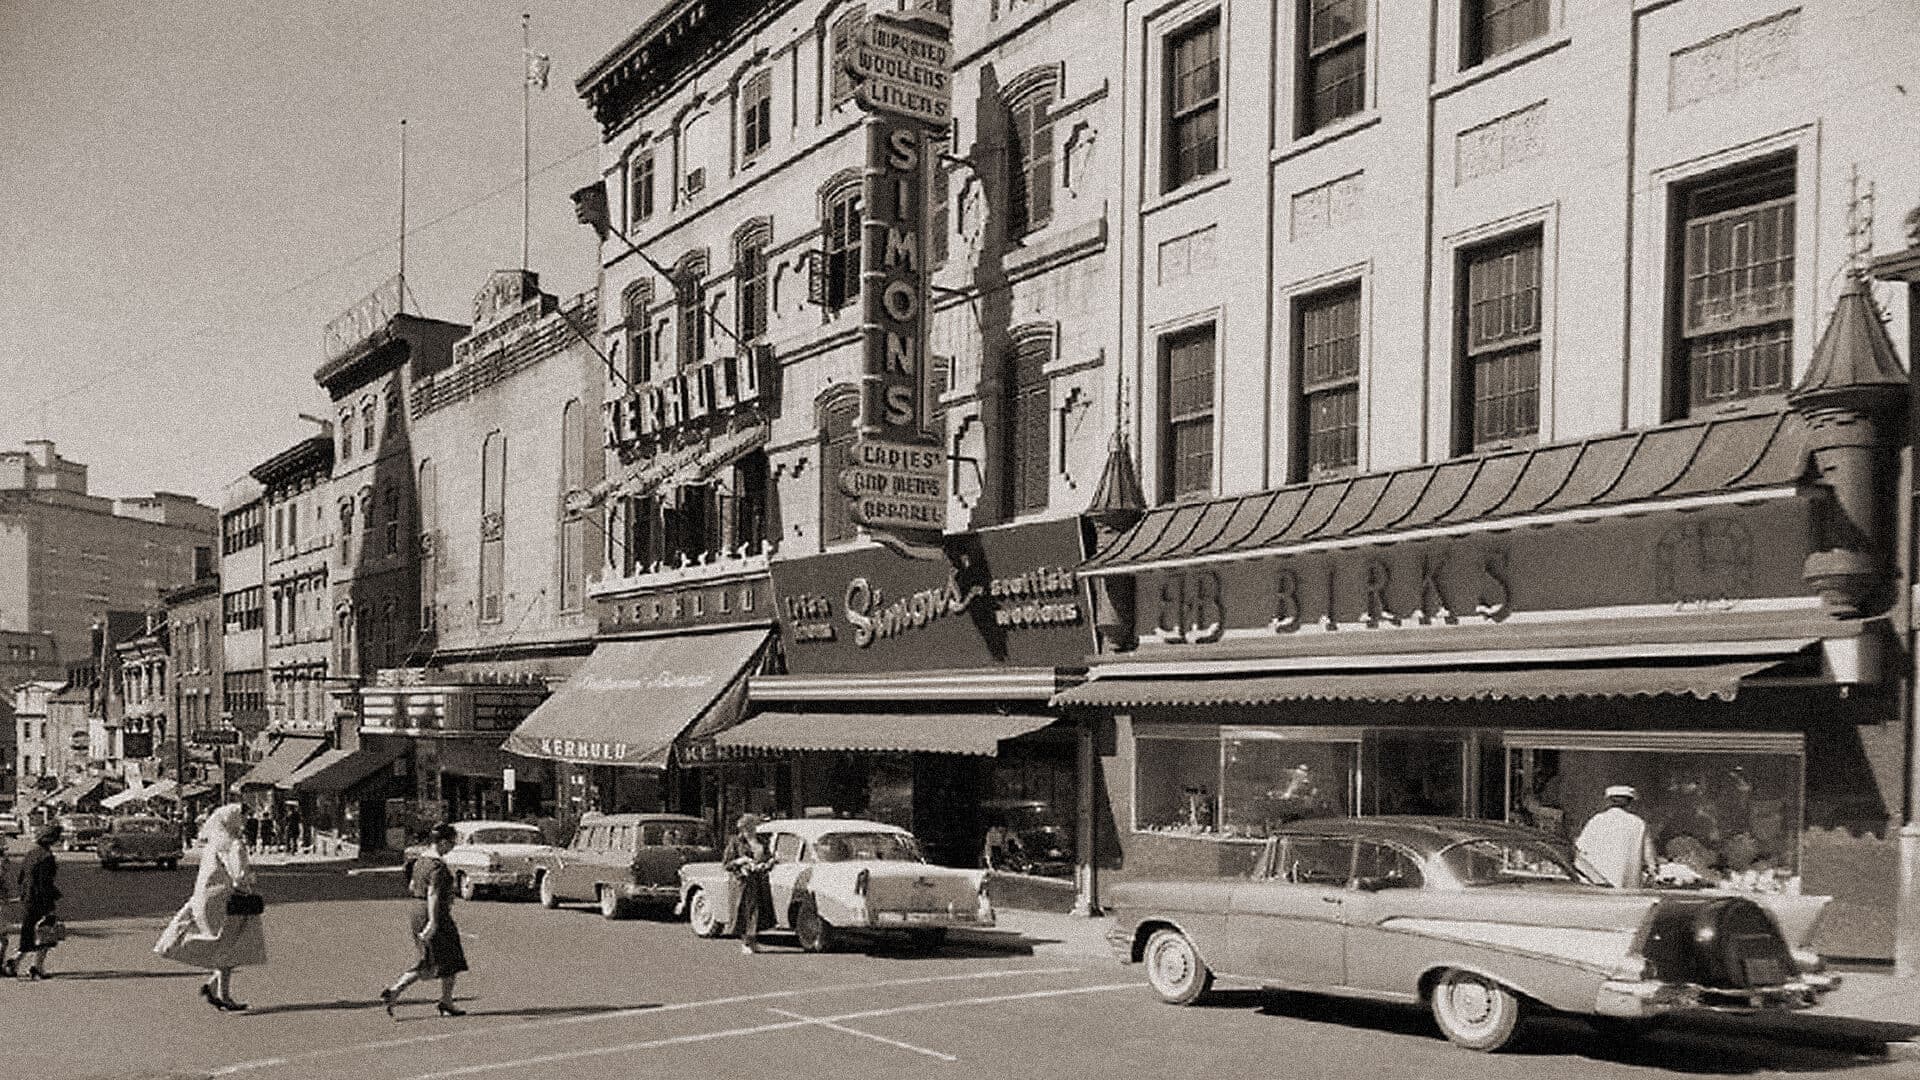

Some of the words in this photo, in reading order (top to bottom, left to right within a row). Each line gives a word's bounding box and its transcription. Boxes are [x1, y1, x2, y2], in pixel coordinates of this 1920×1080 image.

[860, 50, 948, 90] WOOLLENS
[871, 83, 947, 118] LINENS
[883, 127, 918, 425] SIMONS
[601, 346, 759, 448] KERHULU
[854, 471, 887, 494] AND
[844, 565, 984, 648] Simons
[1270, 548, 1513, 634] BIRKS
[541, 738, 628, 760] KERHULU
